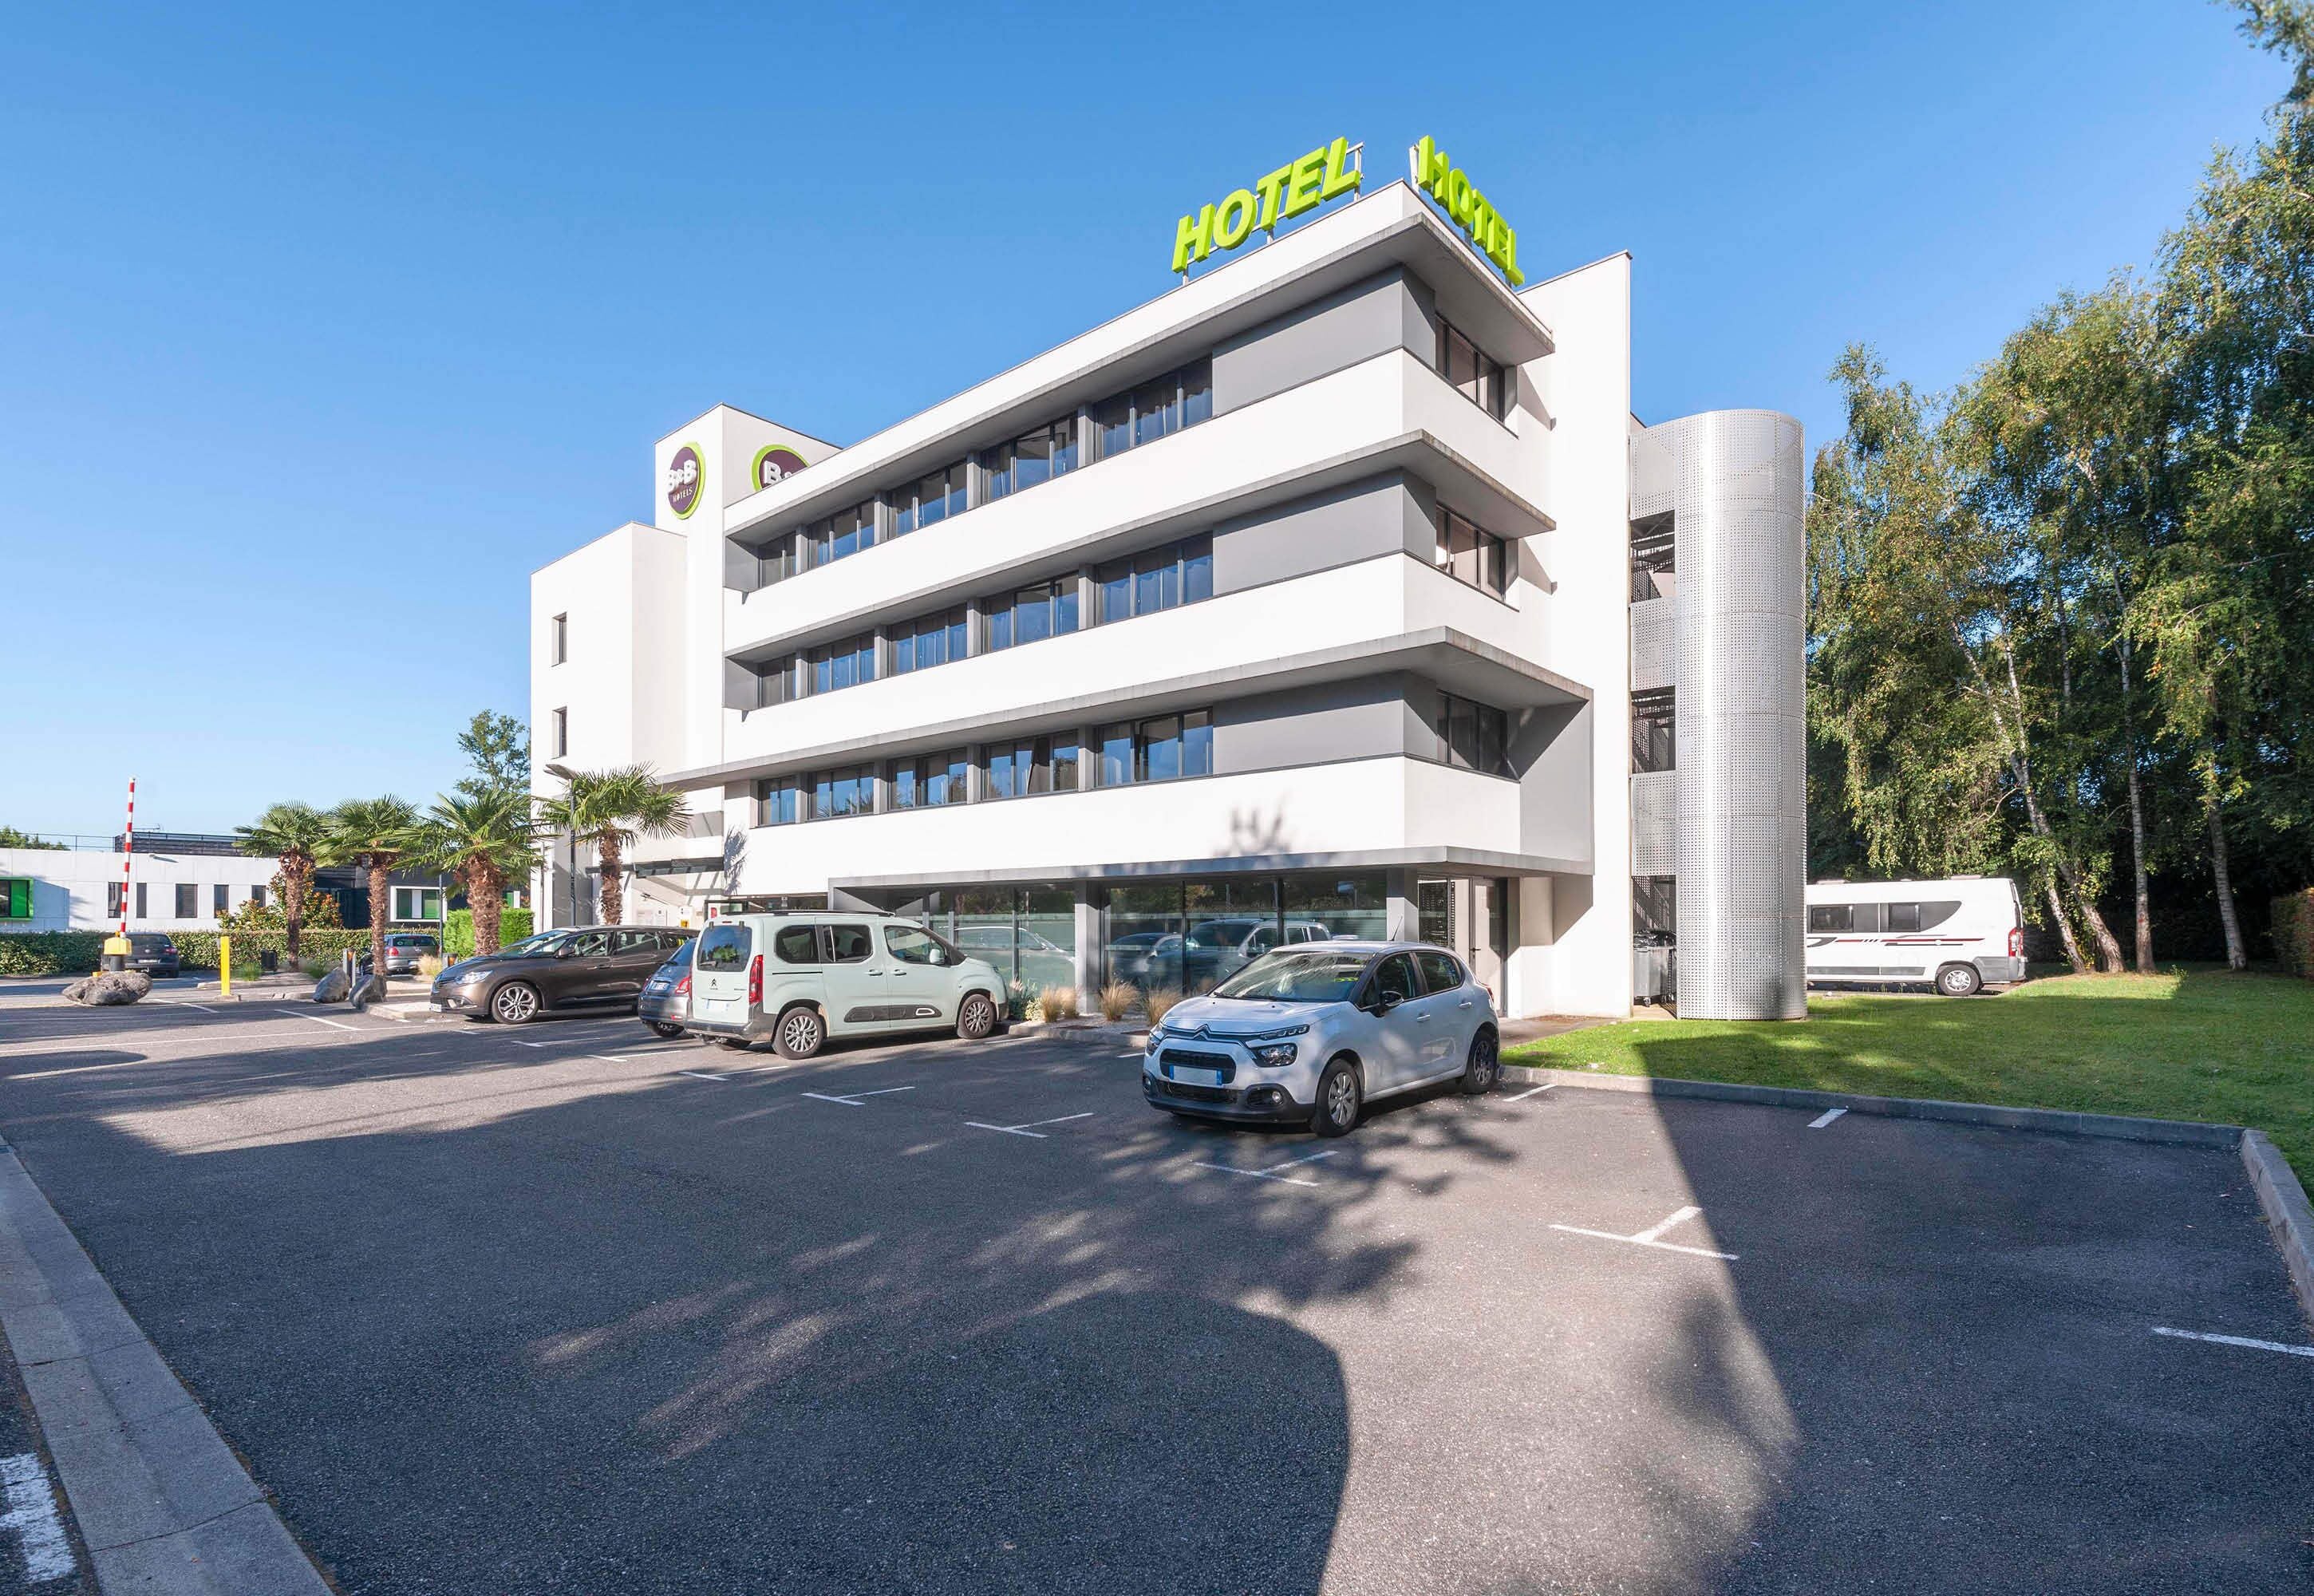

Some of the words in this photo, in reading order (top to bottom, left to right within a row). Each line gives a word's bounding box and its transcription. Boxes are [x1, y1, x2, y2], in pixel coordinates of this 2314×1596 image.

[1171, 136, 1360, 273] HOTEL
[1418, 135, 1525, 286] HOTEL
[666, 459, 697, 493] B&B
[673, 487, 693, 503] HOTELS
